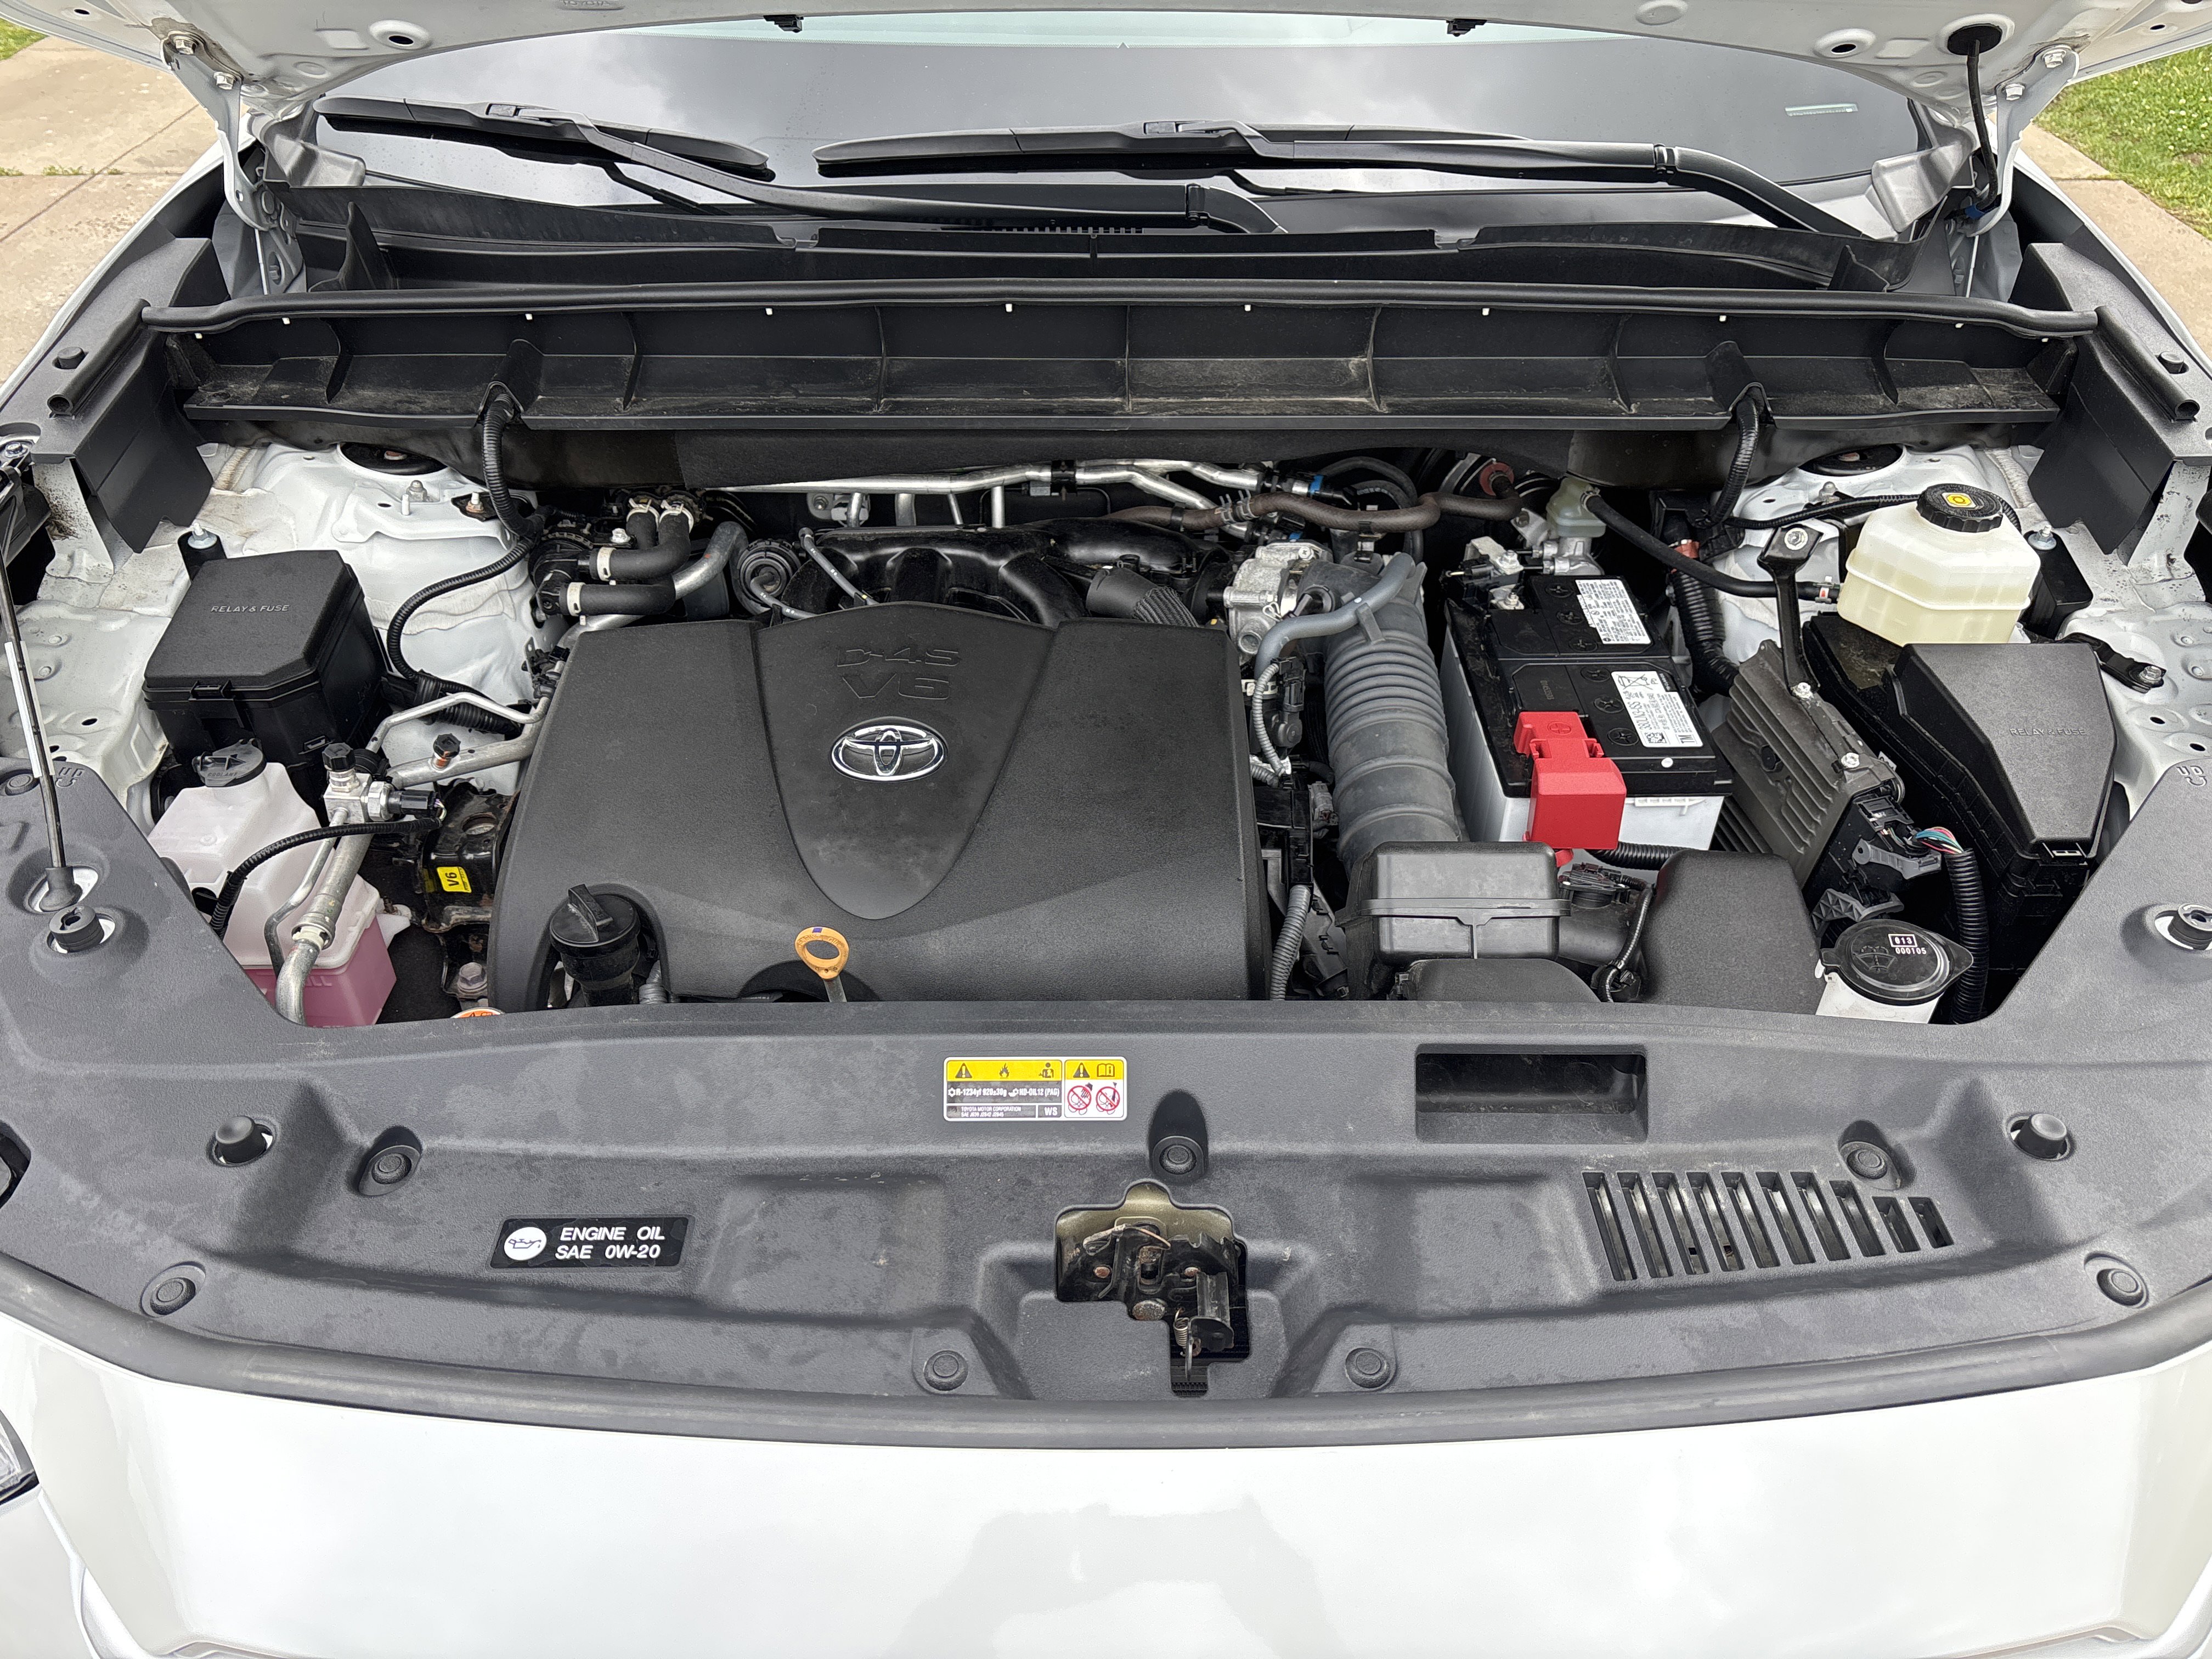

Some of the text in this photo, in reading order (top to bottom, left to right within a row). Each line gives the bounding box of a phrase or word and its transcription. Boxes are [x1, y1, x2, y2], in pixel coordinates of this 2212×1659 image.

[836, 647, 960, 668] D-4S
[841, 672, 951, 701] V6
[2009, 727, 2045, 736] RELAY
[2057, 727, 2087, 736] FUSE
[445, 871, 460, 887] V6
[1045, 1088, 1060, 1097] (PAG)
[1044, 1107, 1058, 1116] WS
[559, 1226, 665, 1242] ENGINE OIL
[555, 1244, 661, 1260] SAE 0W-20
